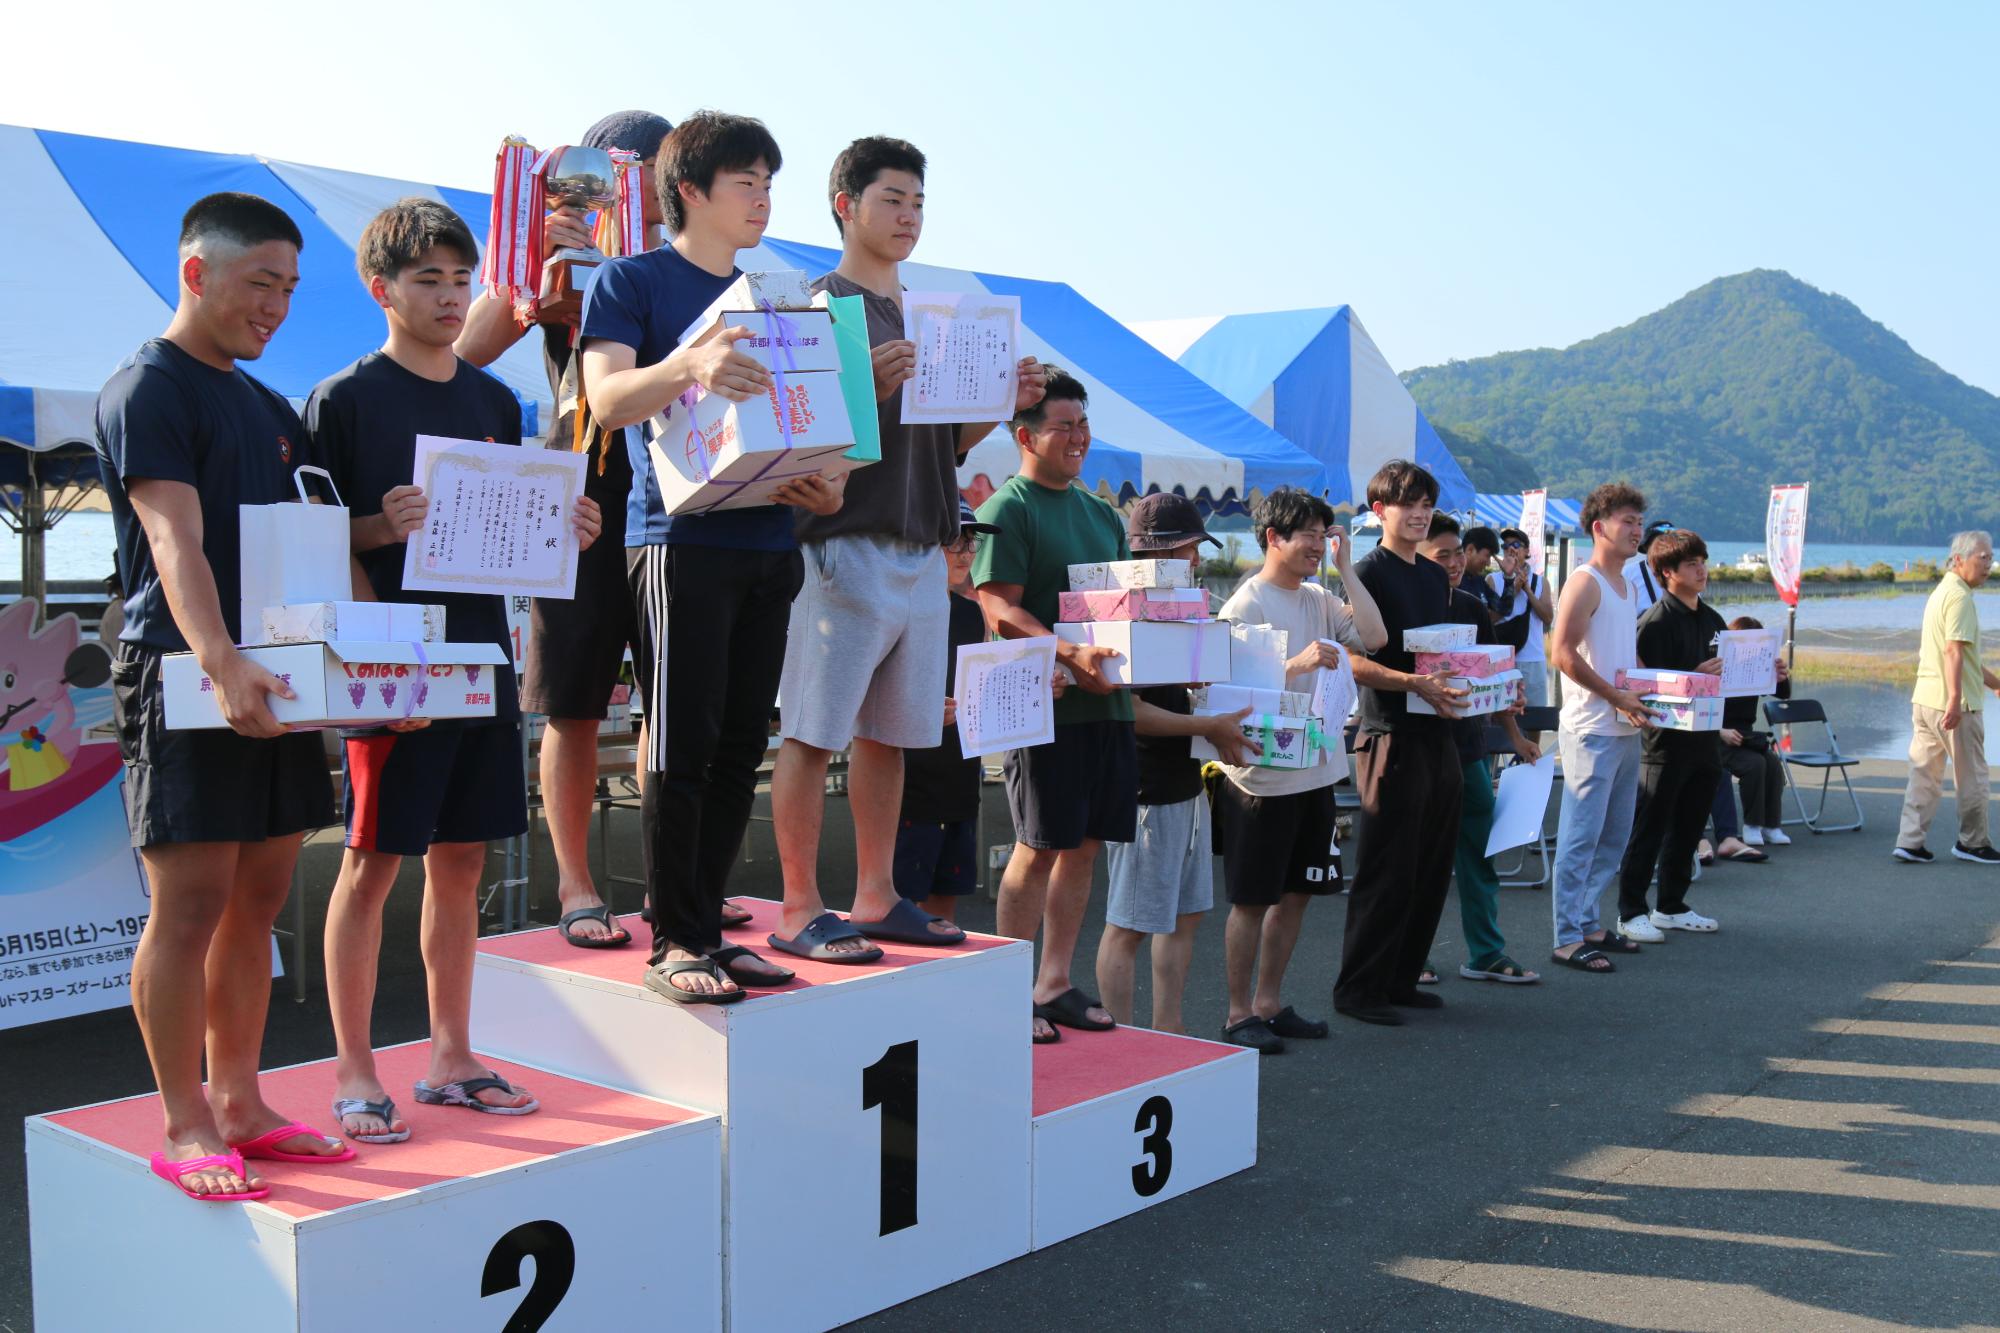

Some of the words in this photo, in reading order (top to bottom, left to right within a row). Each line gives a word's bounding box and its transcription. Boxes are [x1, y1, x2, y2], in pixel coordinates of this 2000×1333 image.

[862, 1039, 919, 1237] 1
[1131, 1095, 1173, 1197] 3
[480, 1219, 576, 1333] 2
